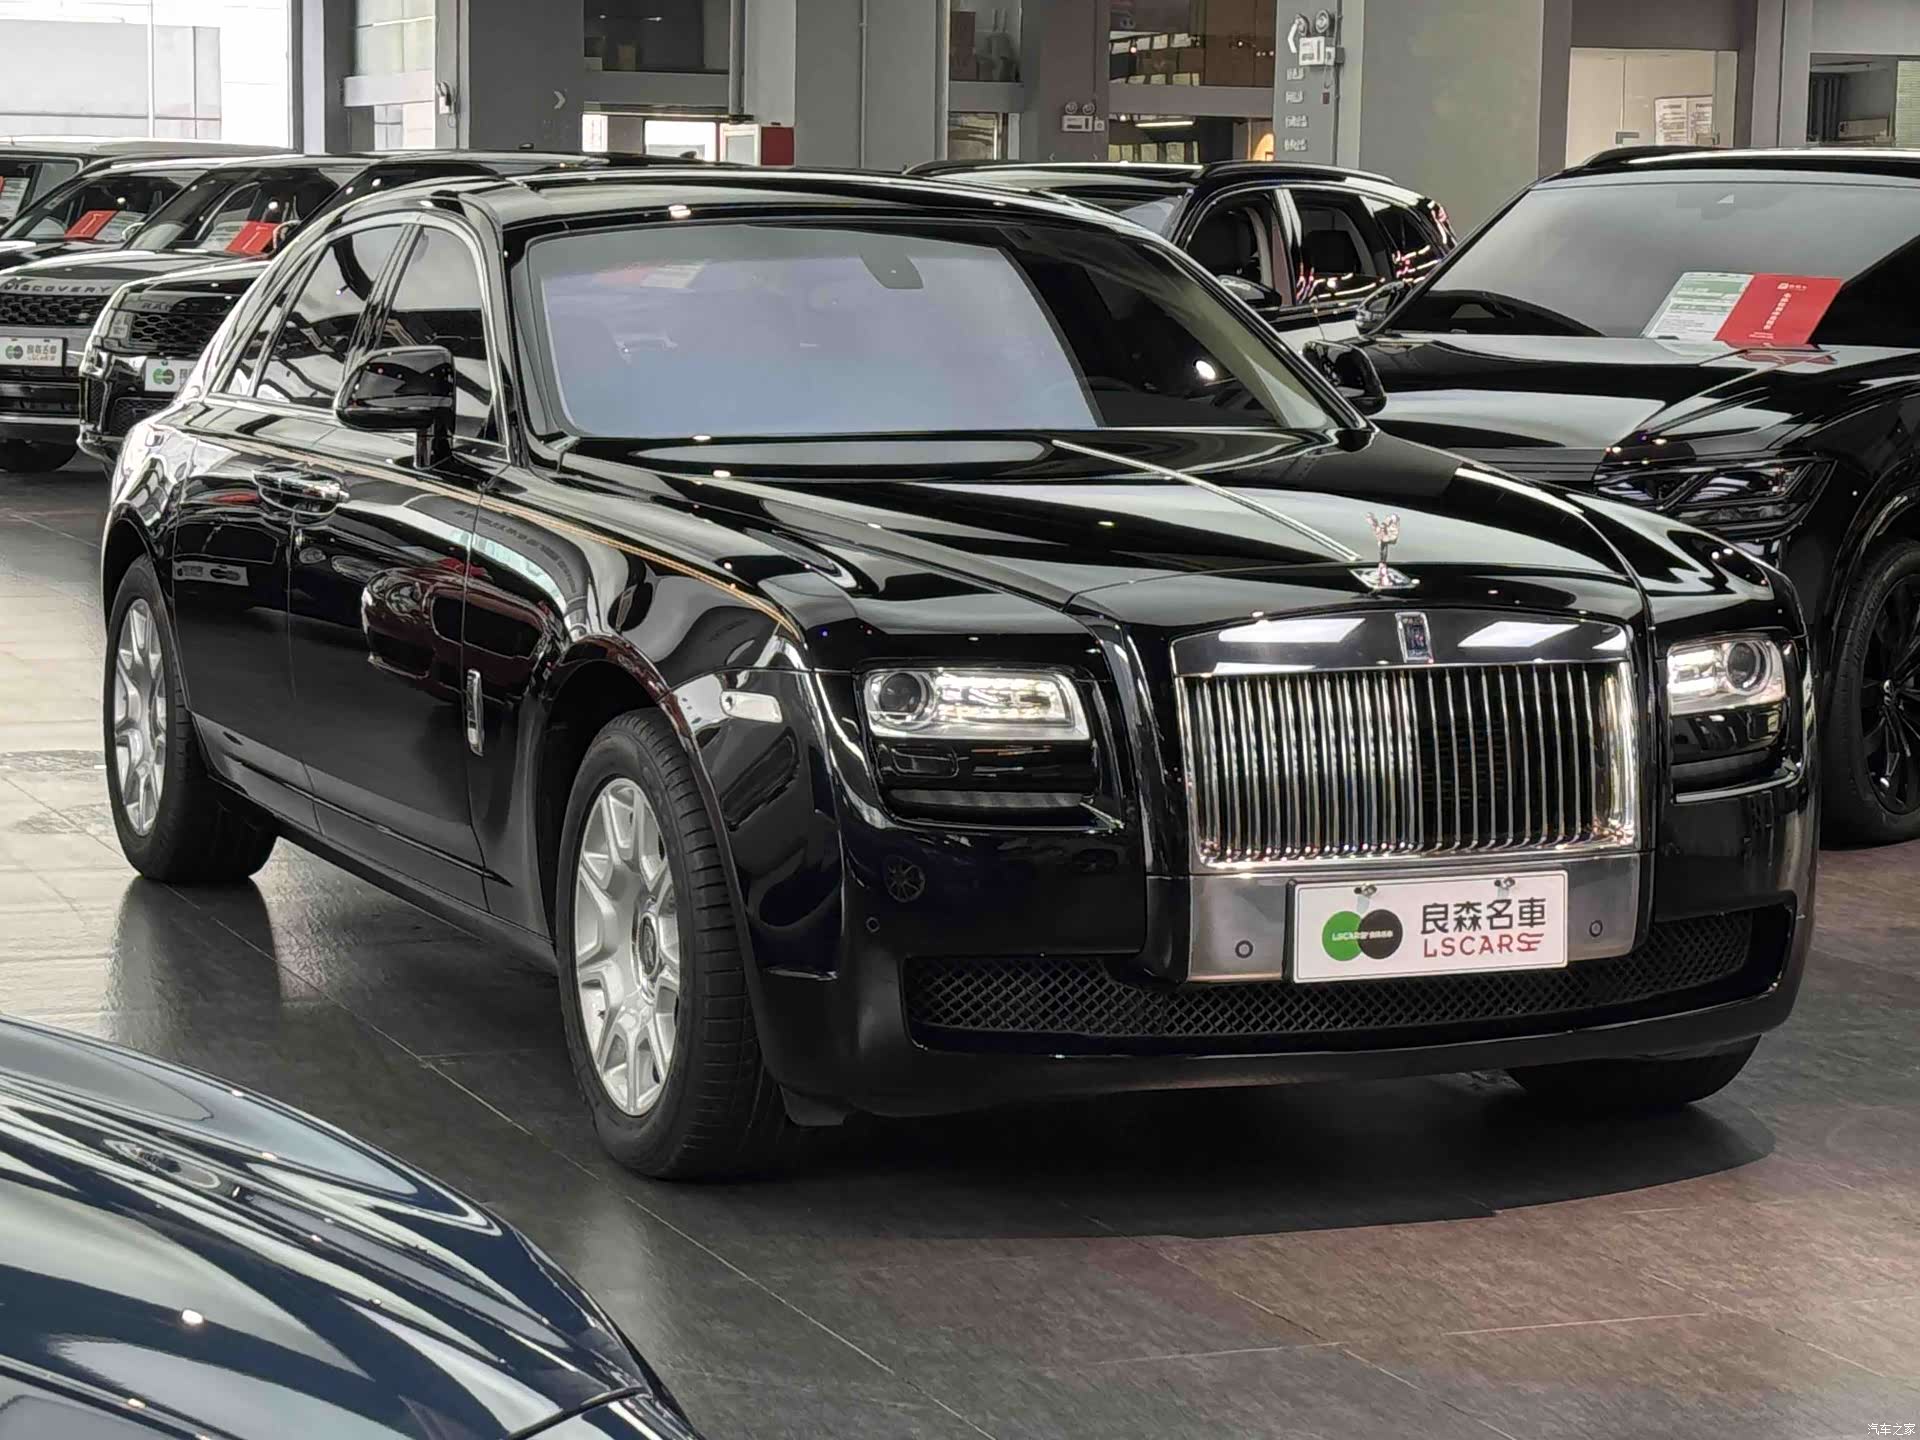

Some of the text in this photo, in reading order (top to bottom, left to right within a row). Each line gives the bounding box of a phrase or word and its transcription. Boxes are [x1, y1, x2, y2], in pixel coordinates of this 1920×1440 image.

[1420, 898, 1546, 935] 良森名車
[1423, 932, 1545, 958] LSCARS
